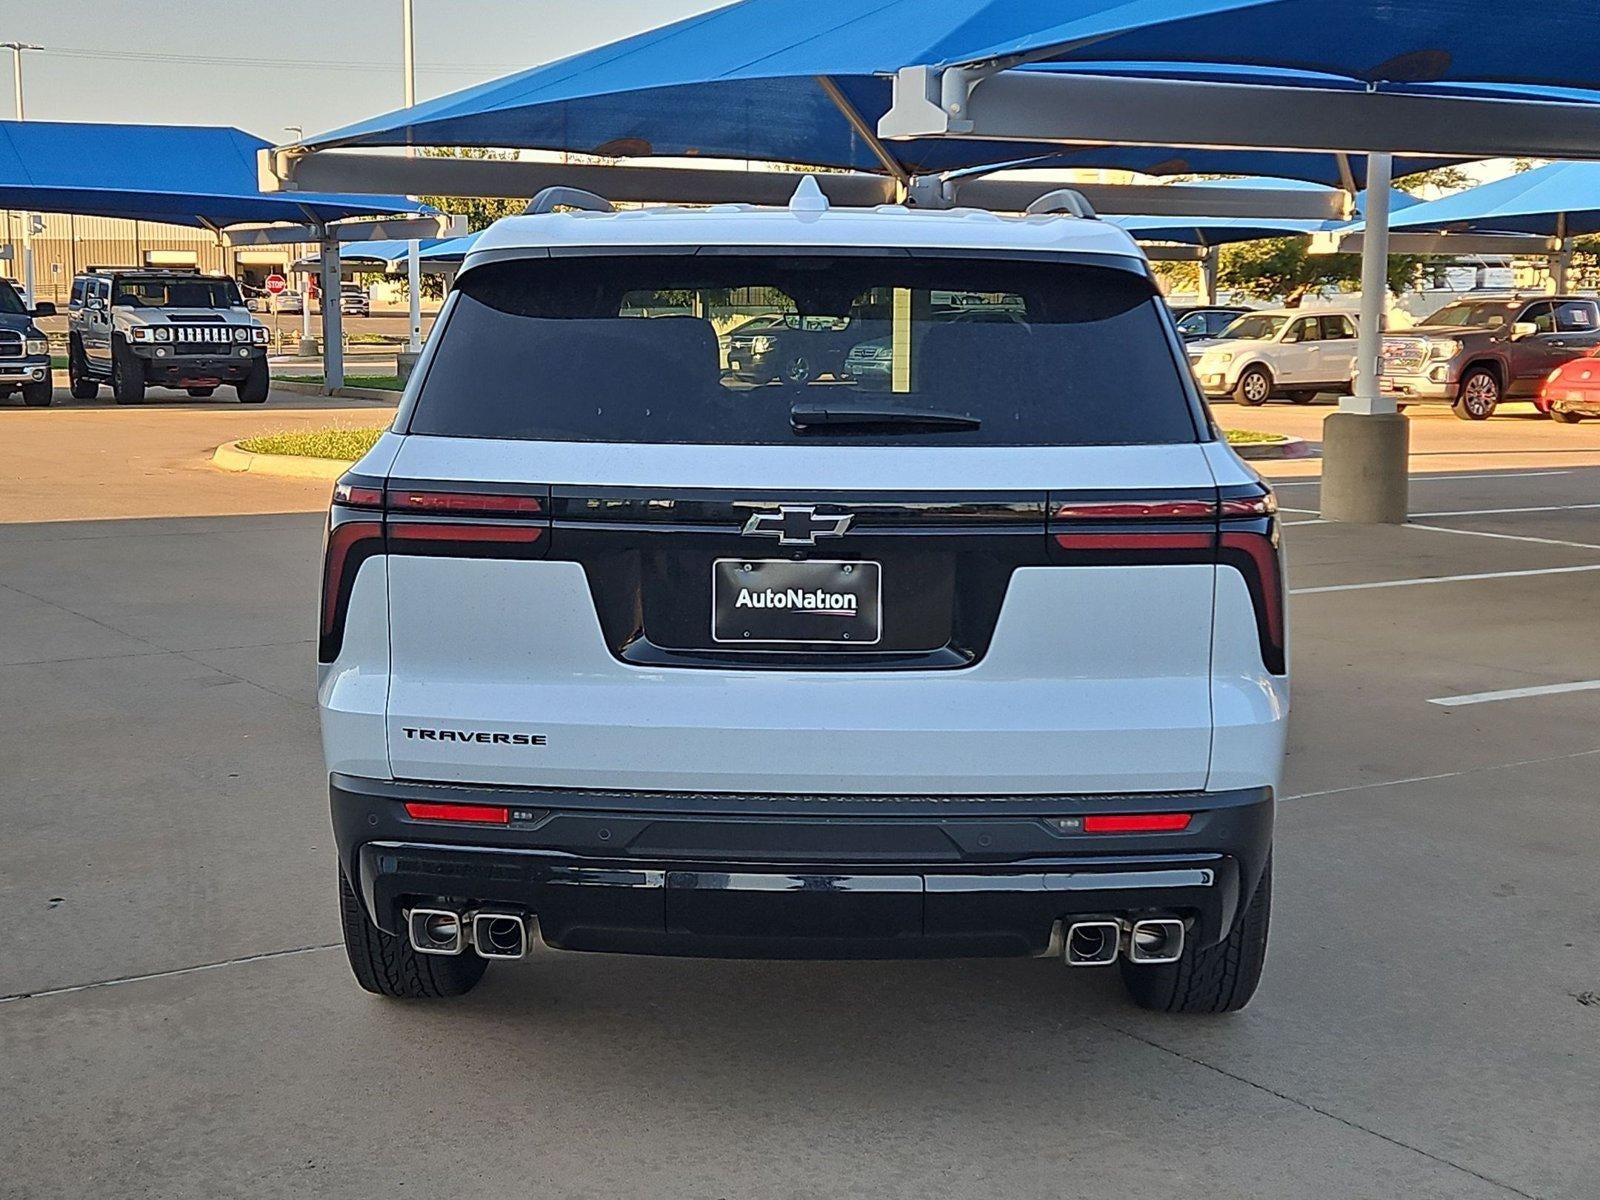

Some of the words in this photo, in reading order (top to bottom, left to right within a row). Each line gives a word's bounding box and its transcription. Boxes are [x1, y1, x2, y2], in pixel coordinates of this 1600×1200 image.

[267, 280, 284, 289] STOP
[735, 588, 858, 610] AutoNation
[402, 727, 547, 746] TRAVERSE
